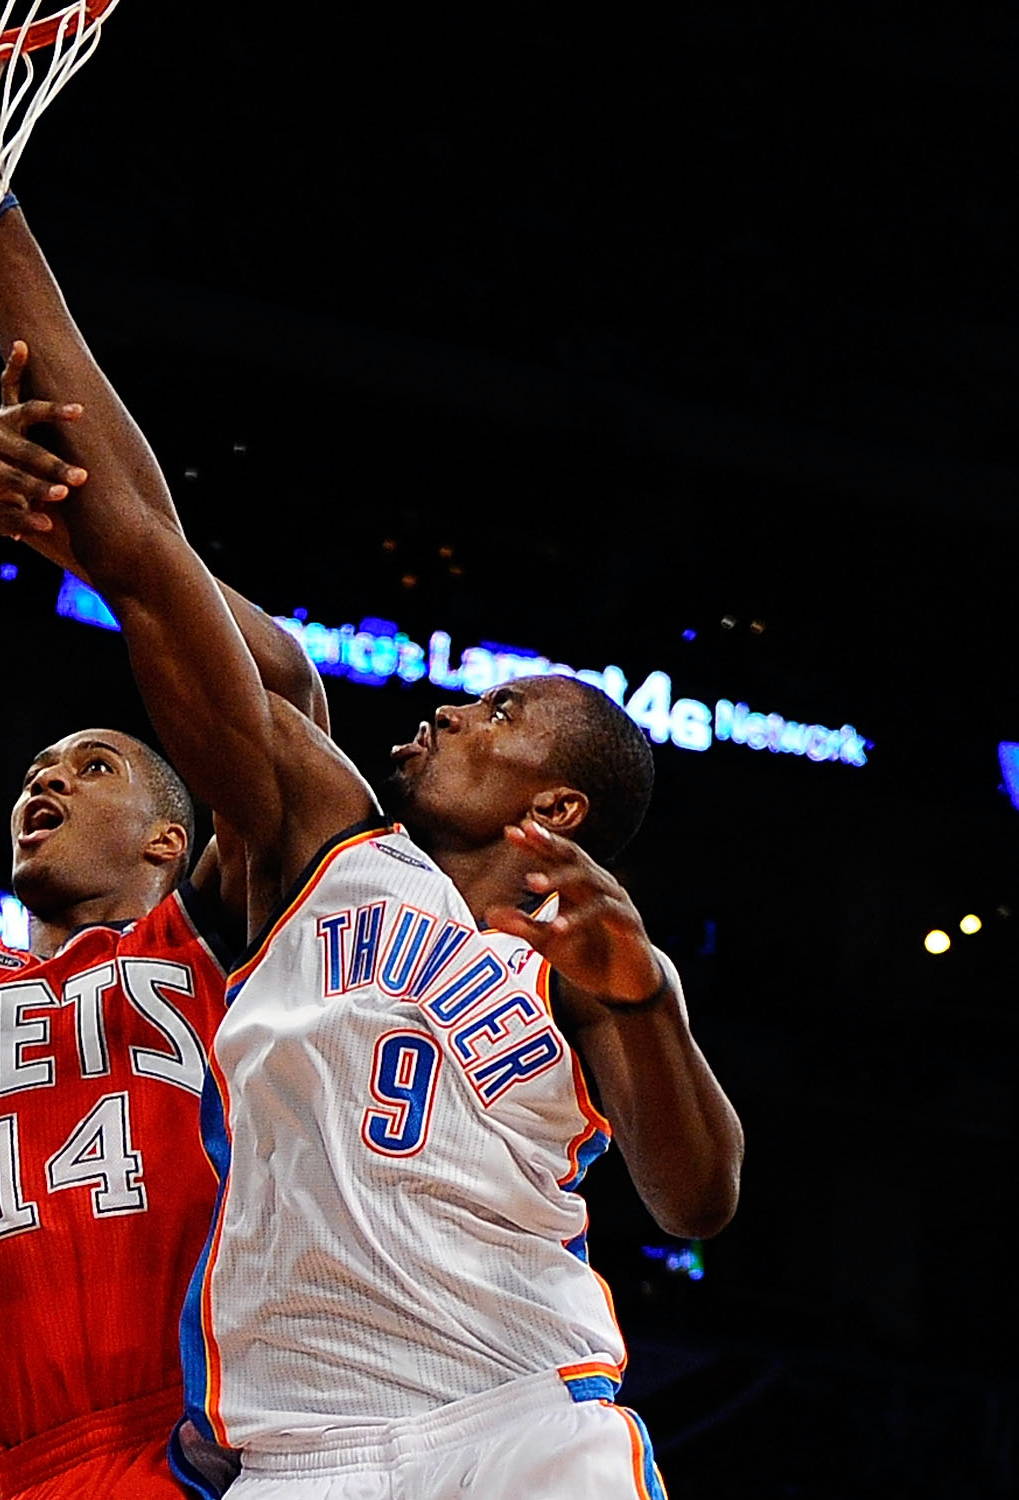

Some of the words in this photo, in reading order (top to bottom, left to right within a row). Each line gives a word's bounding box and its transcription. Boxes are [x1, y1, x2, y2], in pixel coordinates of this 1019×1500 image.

[715, 699, 868, 767] Network
[317, 901, 565, 1109] THUNDER
[361, 1028, 443, 1159] 9
